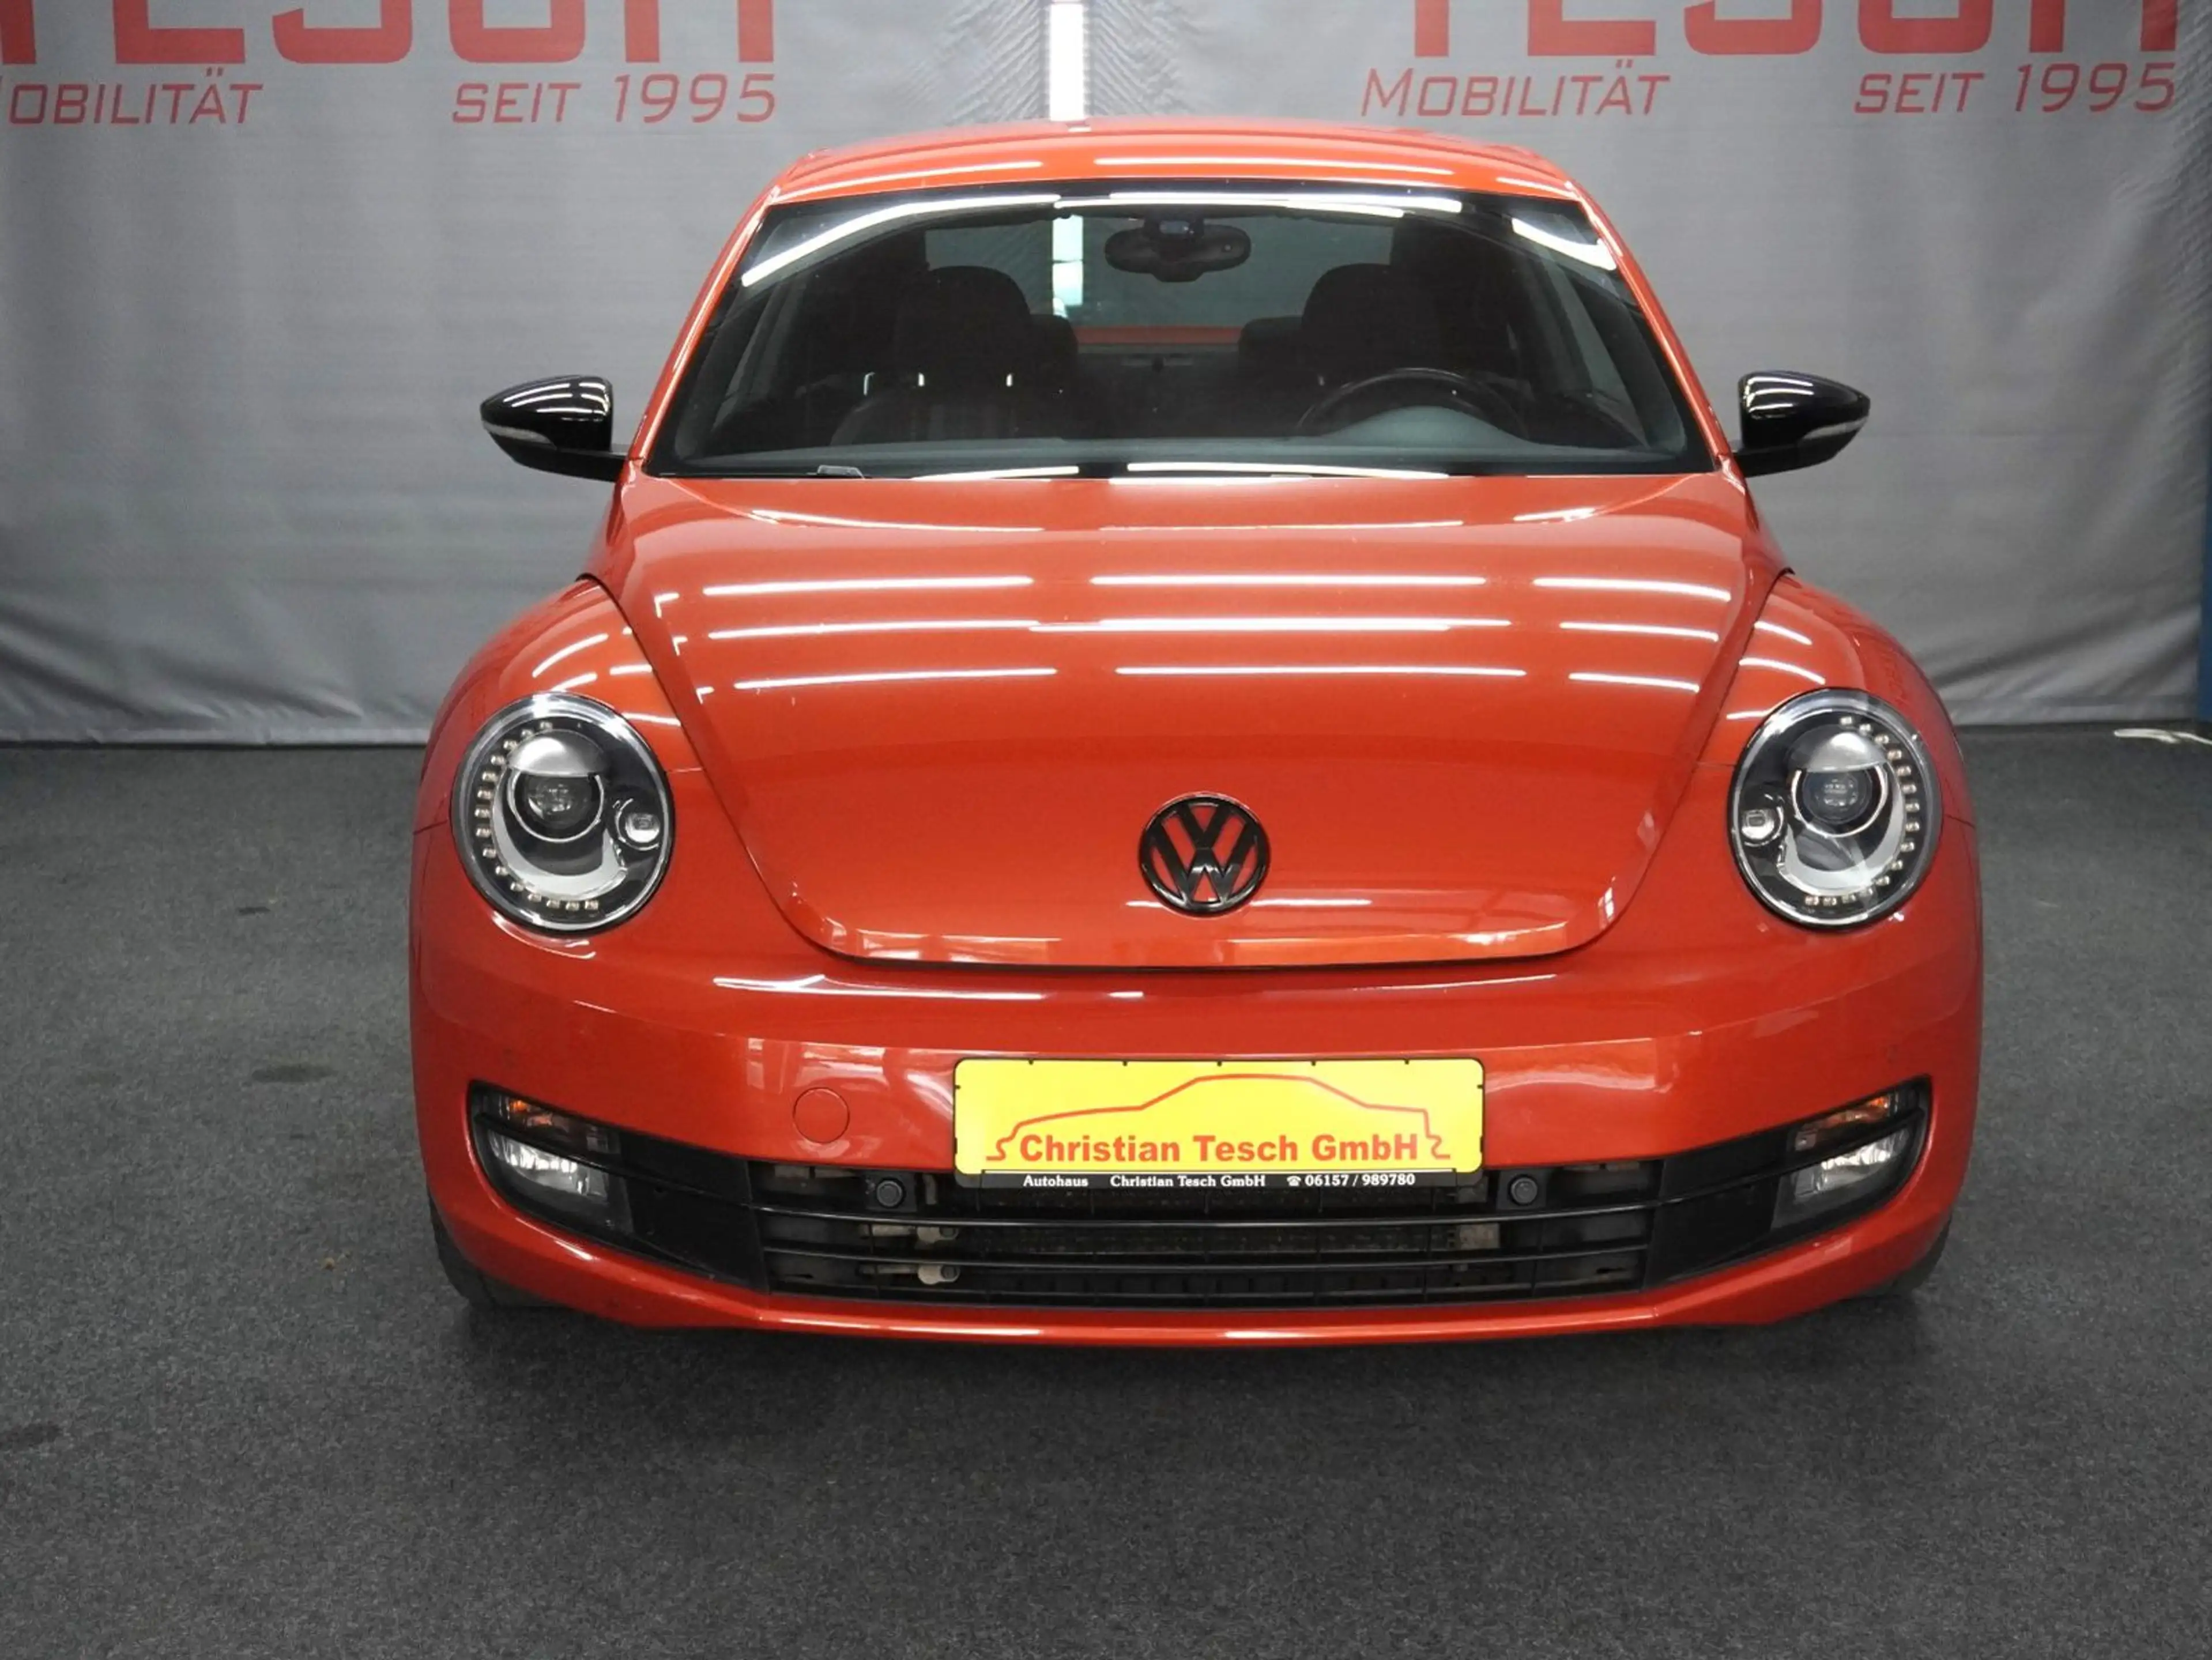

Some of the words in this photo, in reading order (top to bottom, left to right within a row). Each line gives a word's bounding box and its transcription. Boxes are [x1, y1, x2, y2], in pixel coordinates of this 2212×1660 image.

[0, 66, 263, 124] OBILITÄT
[452, 82, 582, 123] SEIT
[613, 73, 777, 124] 1995
[1853, 72, 1984, 114] SEIT
[2015, 62, 2176, 114] 1995
[1019, 1134, 1181, 1163] Christian
[1193, 1134, 1298, 1162] Tesch
[1311, 1133, 1418, 1162] GmbH
[1023, 1175, 1088, 1187] Autohaus
[1110, 1174, 1174, 1187] Christian
[1177, 1174, 1216, 1187] Tesch
[1220, 1174, 1266, 1187] GmbH
[1304, 1174, 1350, 1187] 06157
[1362, 1172, 1416, 1186] 989780
